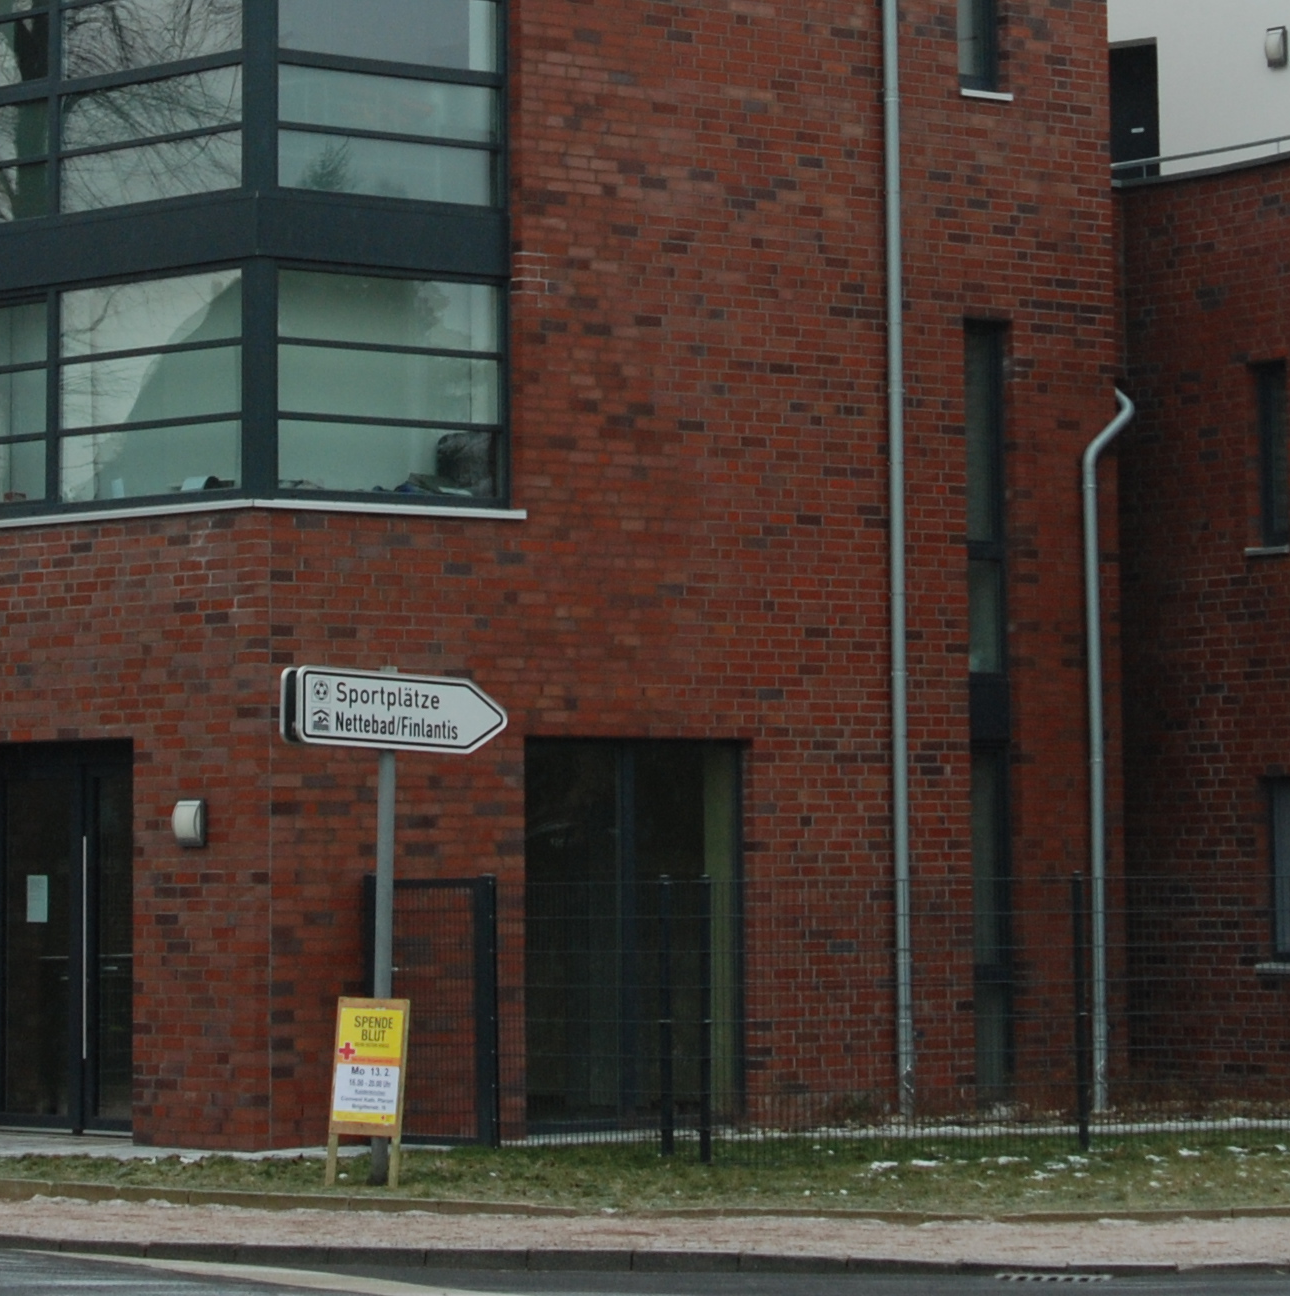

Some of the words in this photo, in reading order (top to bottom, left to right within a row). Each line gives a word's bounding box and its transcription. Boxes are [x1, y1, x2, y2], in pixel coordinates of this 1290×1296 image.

[336, 681, 441, 711] Sportplätze
[335, 711, 459, 741] Nettebad/Finlantis
[354, 1015, 393, 1029] SPENDE
[361, 1029, 386, 1041] BLUT
[351, 1066, 365, 1076] Mo
[371, 1067, 382, 1077] 13.
